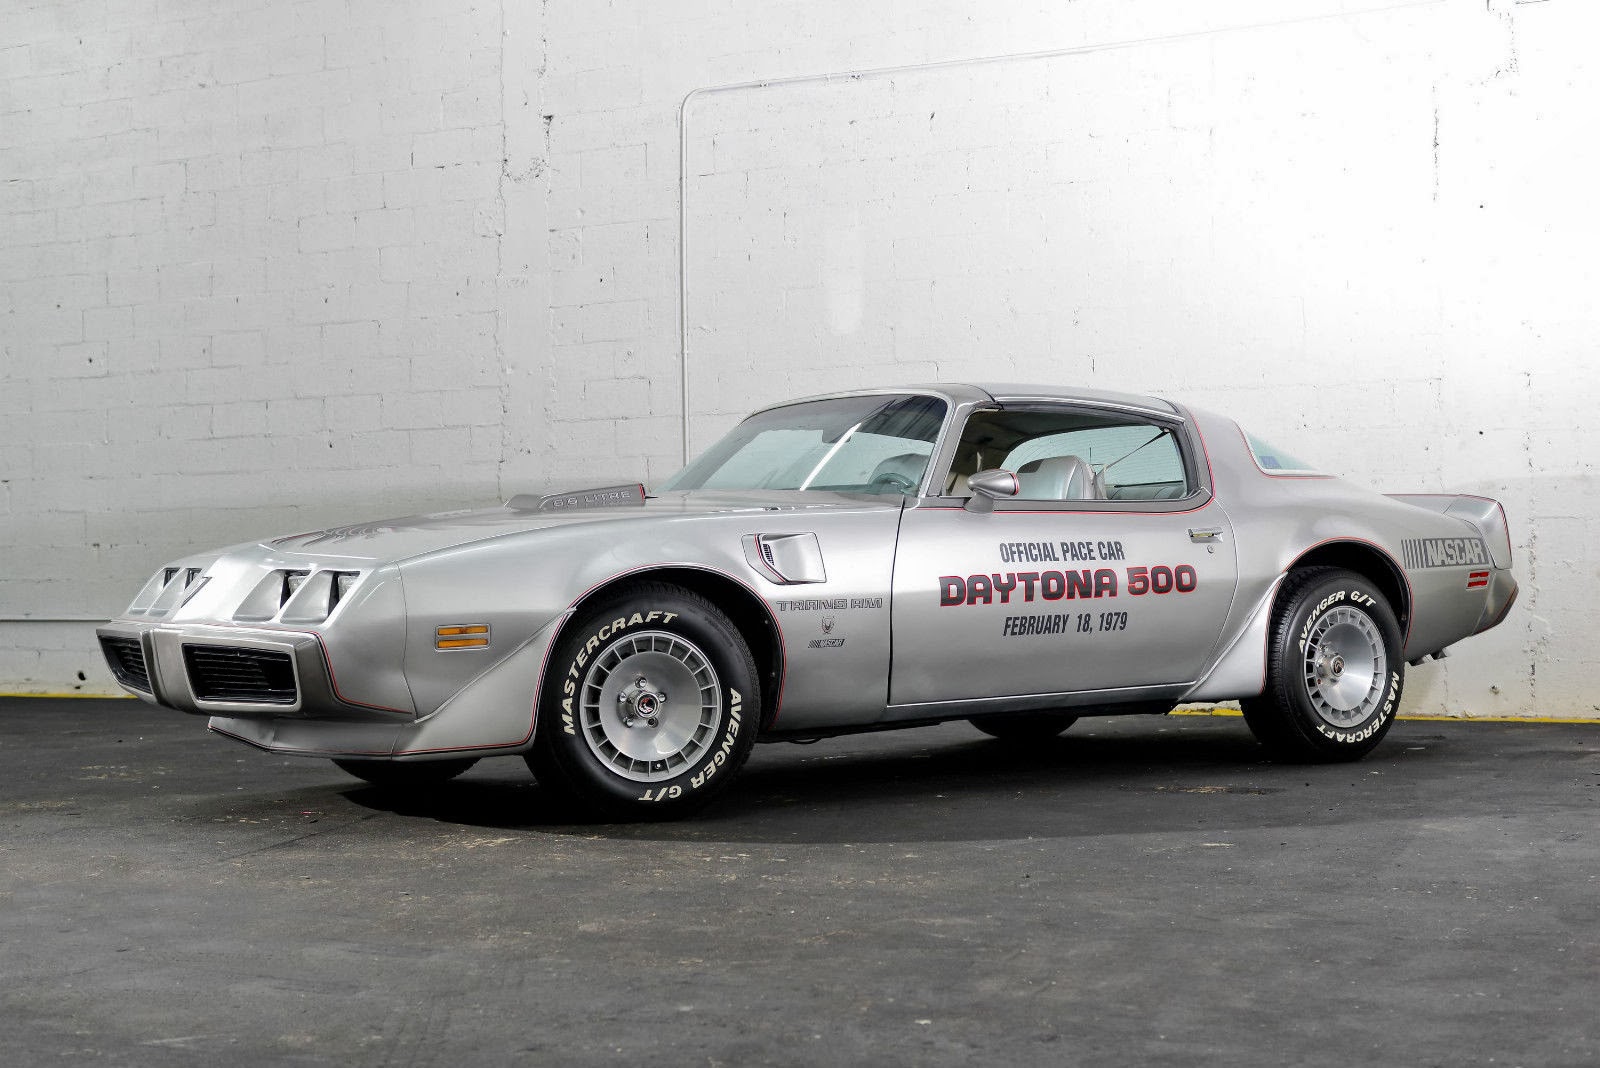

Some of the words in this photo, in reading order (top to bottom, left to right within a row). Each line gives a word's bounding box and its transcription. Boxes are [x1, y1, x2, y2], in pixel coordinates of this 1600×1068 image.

[1000, 542, 1059, 563] OFFICIAL
[1061, 541, 1096, 562] PACE
[1098, 541, 1126, 561] CAR
[1425, 539, 1486, 566] NASCAR
[938, 568, 1118, 607] DAYTONA
[1126, 564, 1198, 596] 500
[776, 599, 847, 612] TRANS
[850, 598, 883, 609] AM
[1298, 590, 1346, 654] AVENGER
[1350, 590, 1377, 607] G/T
[1003, 614, 1070, 637] FEBRUARY
[1076, 613, 1093, 635] 18,
[1098, 611, 1128, 632] 1979
[561, 611, 679, 735] MASTERCRAFT
[1316, 671, 1400, 743] MASTERCRAFT
[690, 687, 742, 789] AVENGER
[638, 785, 682, 801] G/T
